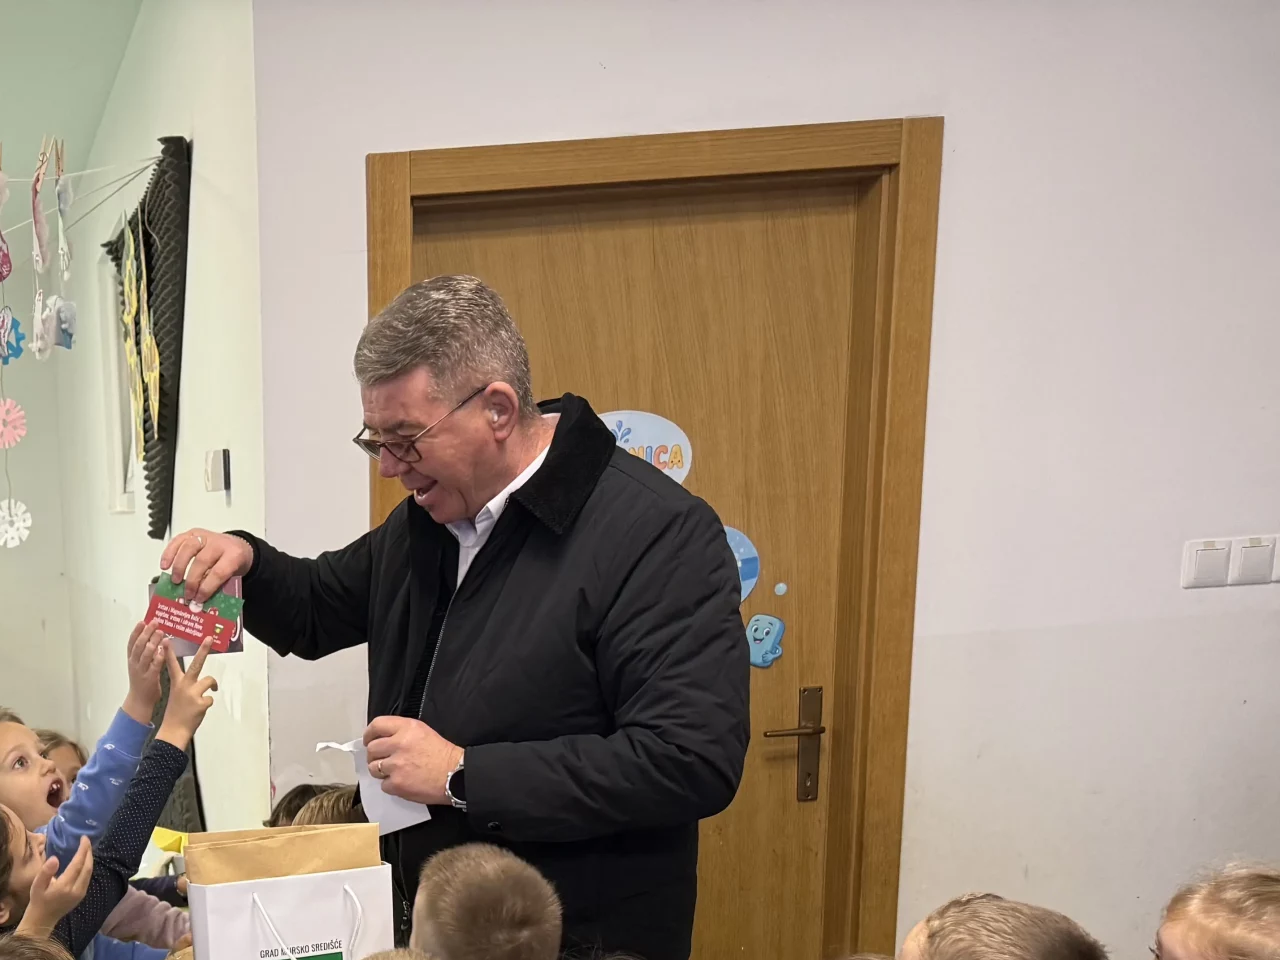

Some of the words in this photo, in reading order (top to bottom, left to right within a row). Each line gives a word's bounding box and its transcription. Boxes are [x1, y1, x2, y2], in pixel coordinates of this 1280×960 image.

[628, 444, 683, 469] ICA
[260, 948, 279, 958] GRAD
[311, 939, 342, 952] SREDIŠĆE
